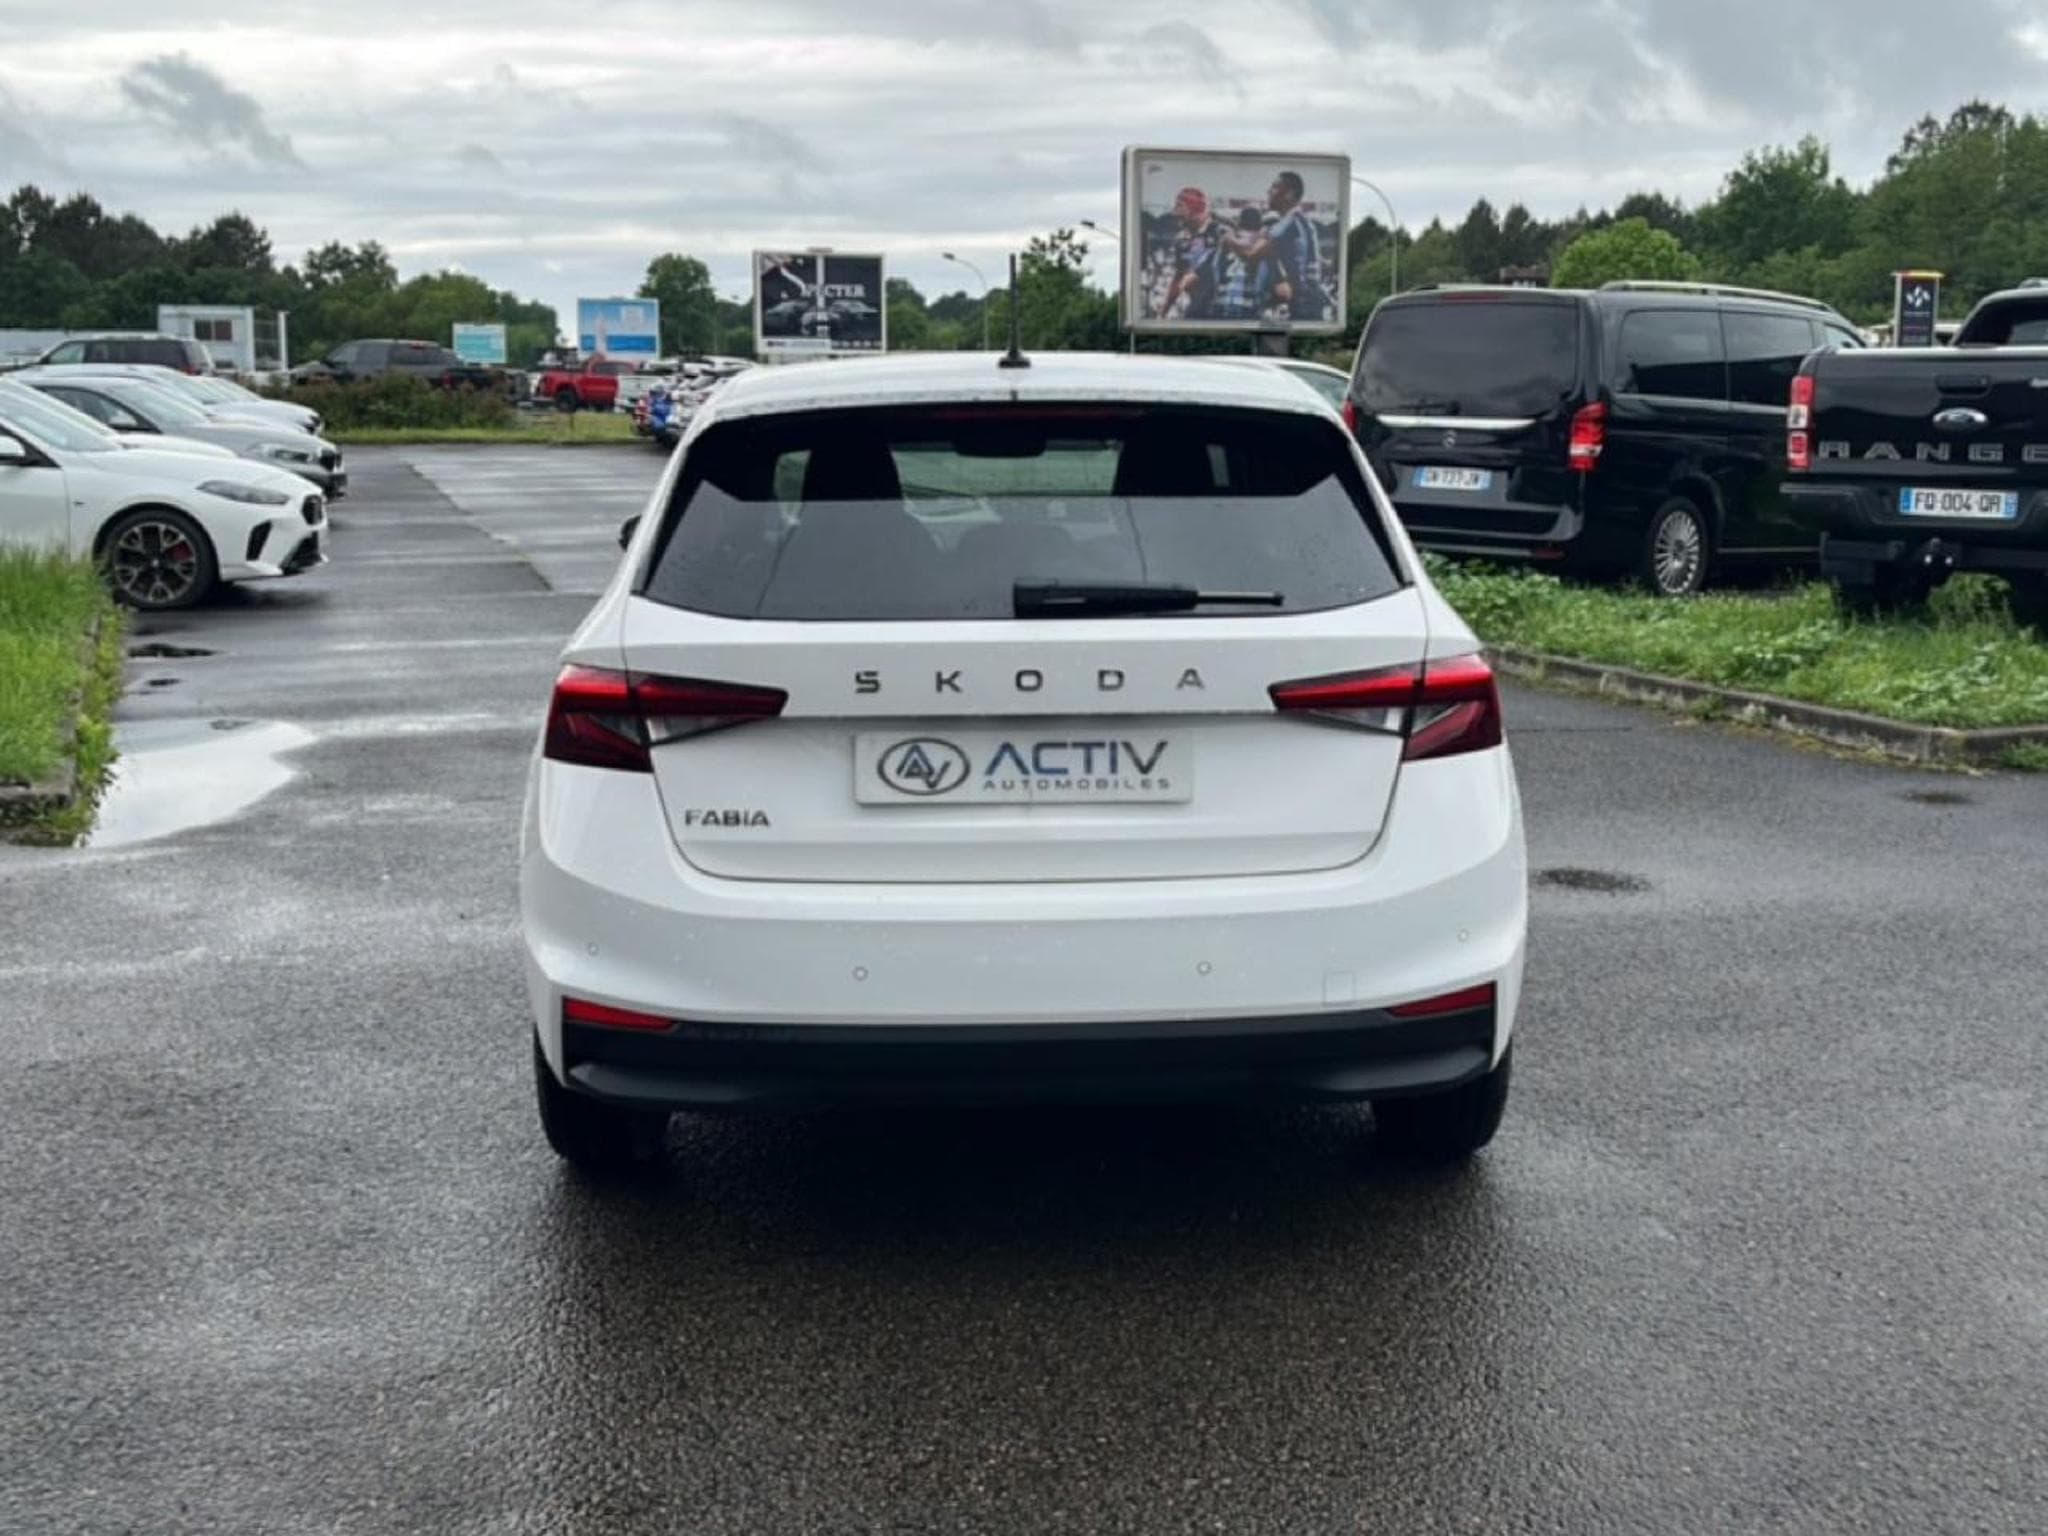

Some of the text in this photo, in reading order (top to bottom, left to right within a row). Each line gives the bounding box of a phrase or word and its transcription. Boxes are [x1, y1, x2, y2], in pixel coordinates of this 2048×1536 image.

[854, 668, 1205, 694] SKODA
[984, 741, 1169, 776] ACTIV
[983, 778, 1171, 791] AUTOMOBILES
[684, 808, 771, 827] FABIA
